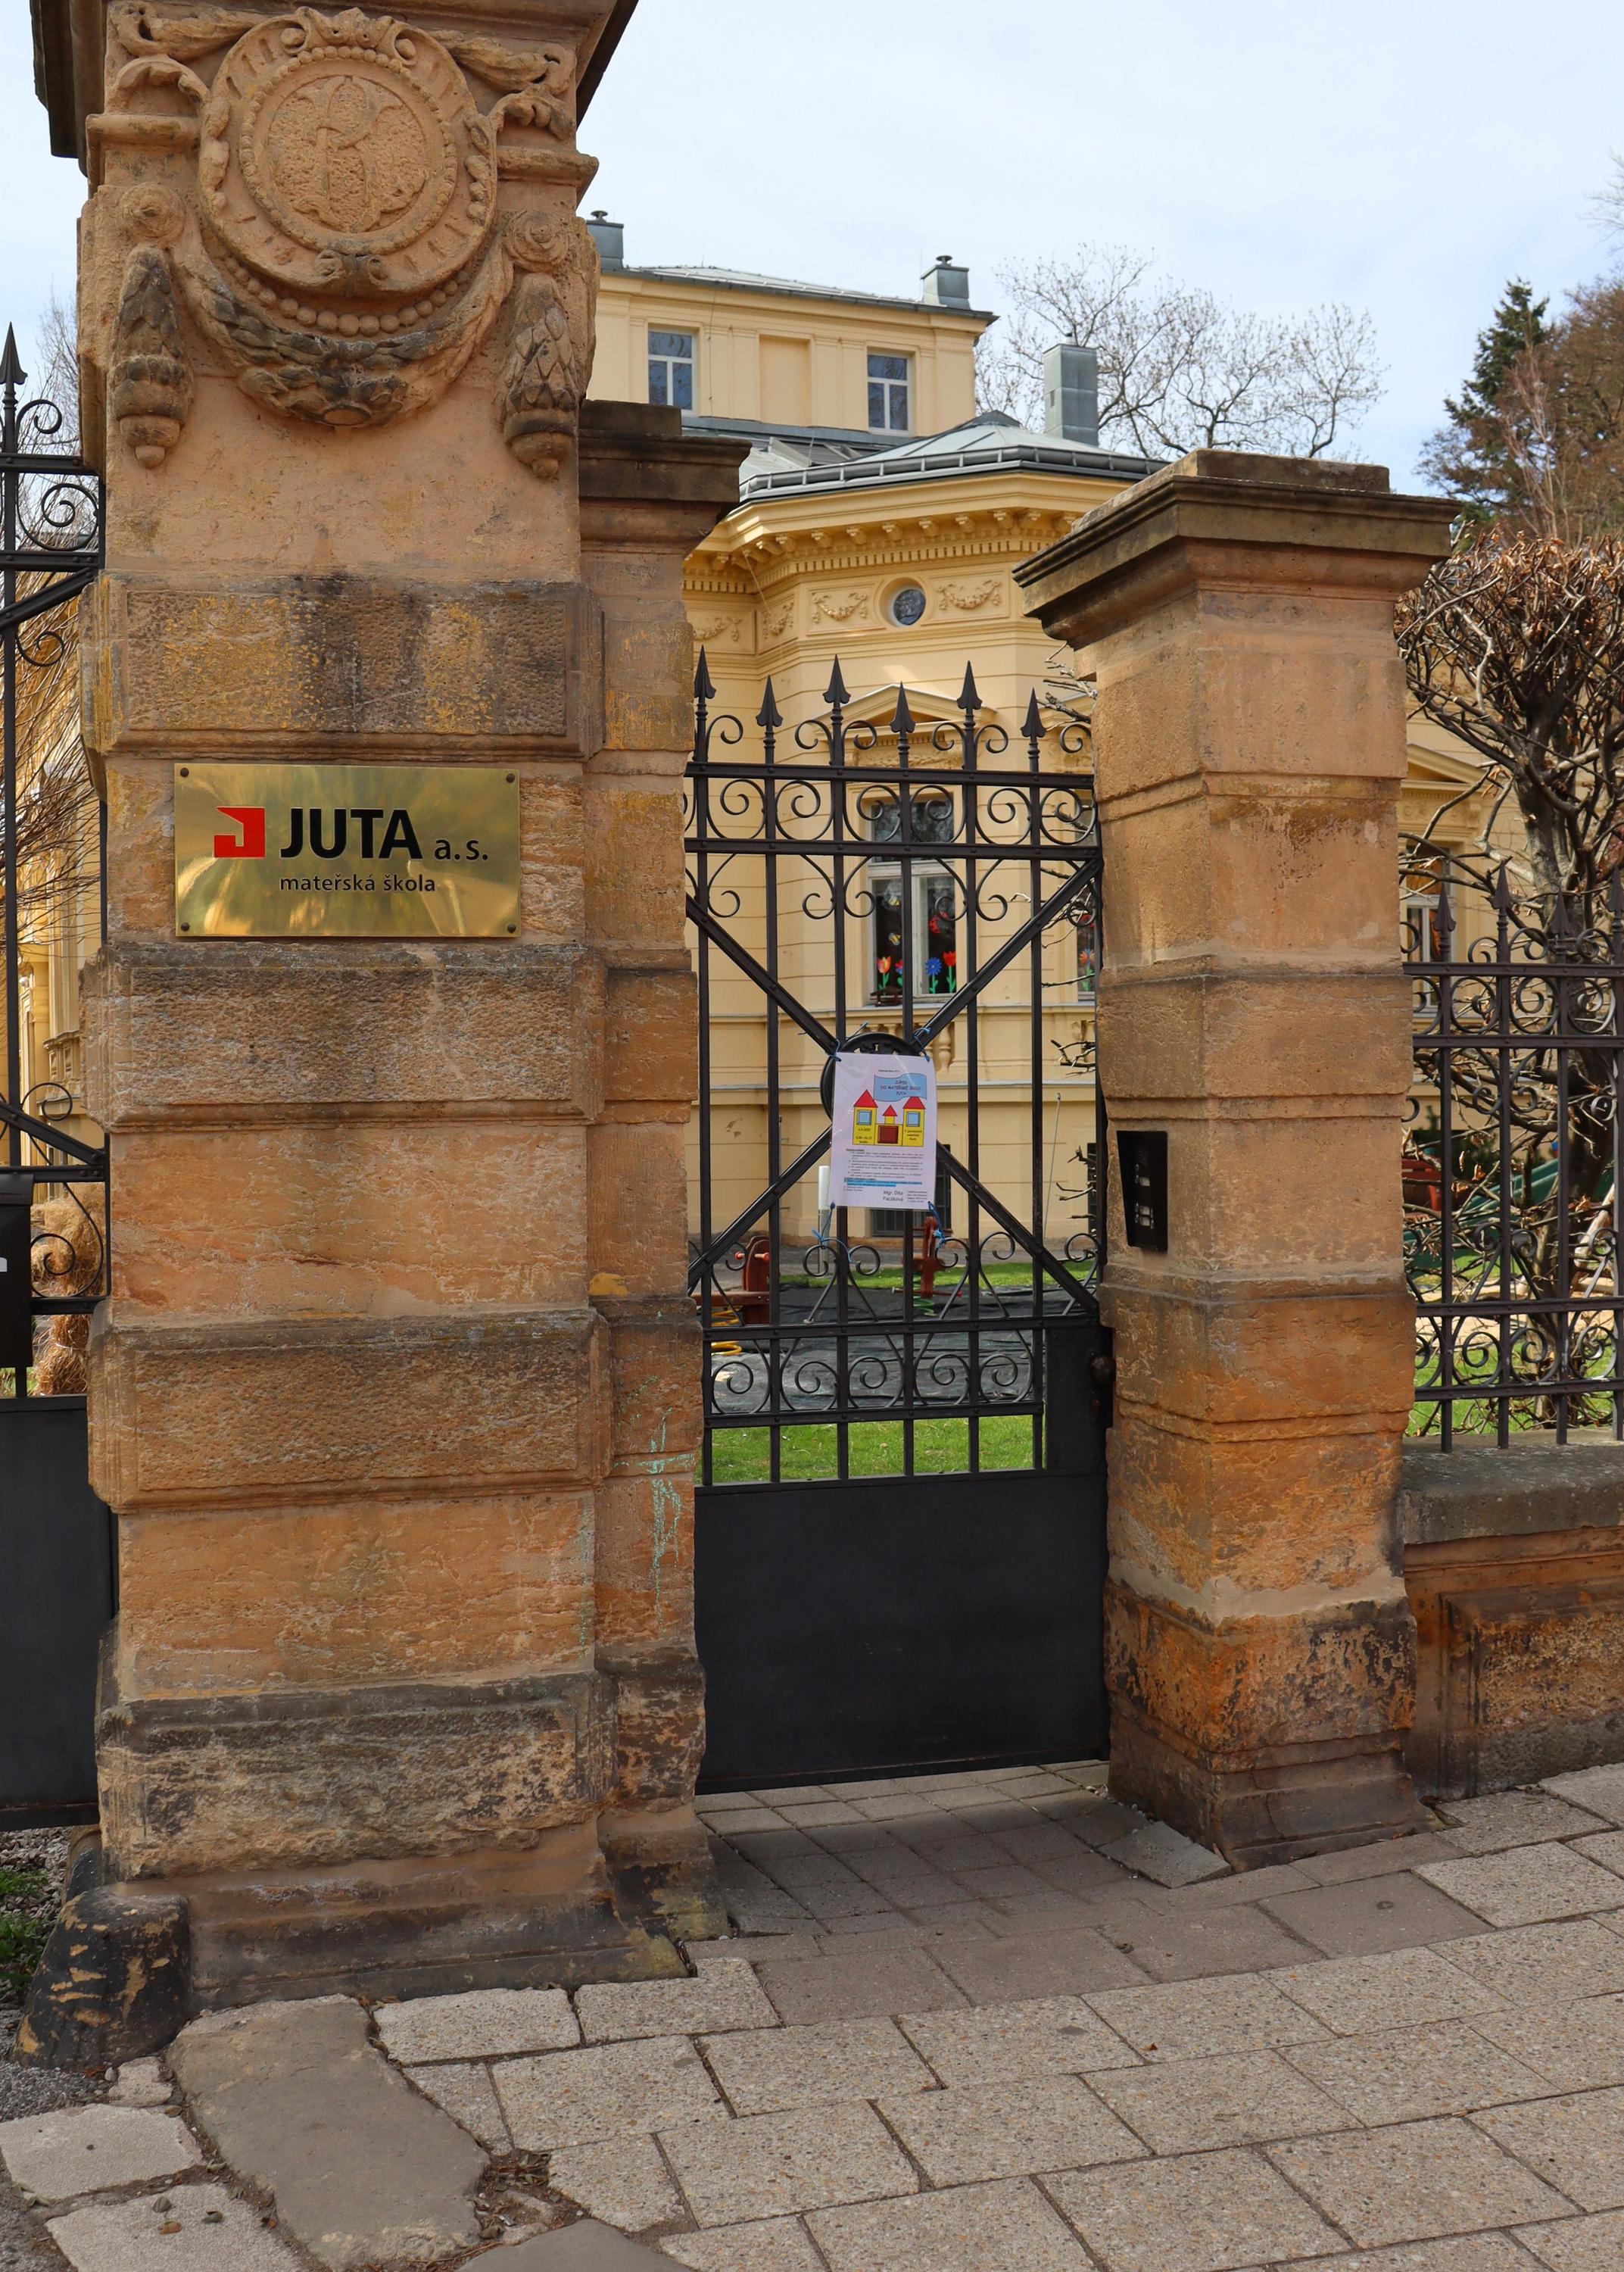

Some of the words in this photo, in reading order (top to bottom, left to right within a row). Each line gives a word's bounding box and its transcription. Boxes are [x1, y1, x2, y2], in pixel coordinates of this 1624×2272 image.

[280, 808, 423, 860] JUTA
[280, 873, 376, 891] mateřská
[383, 873, 436, 892] škola
